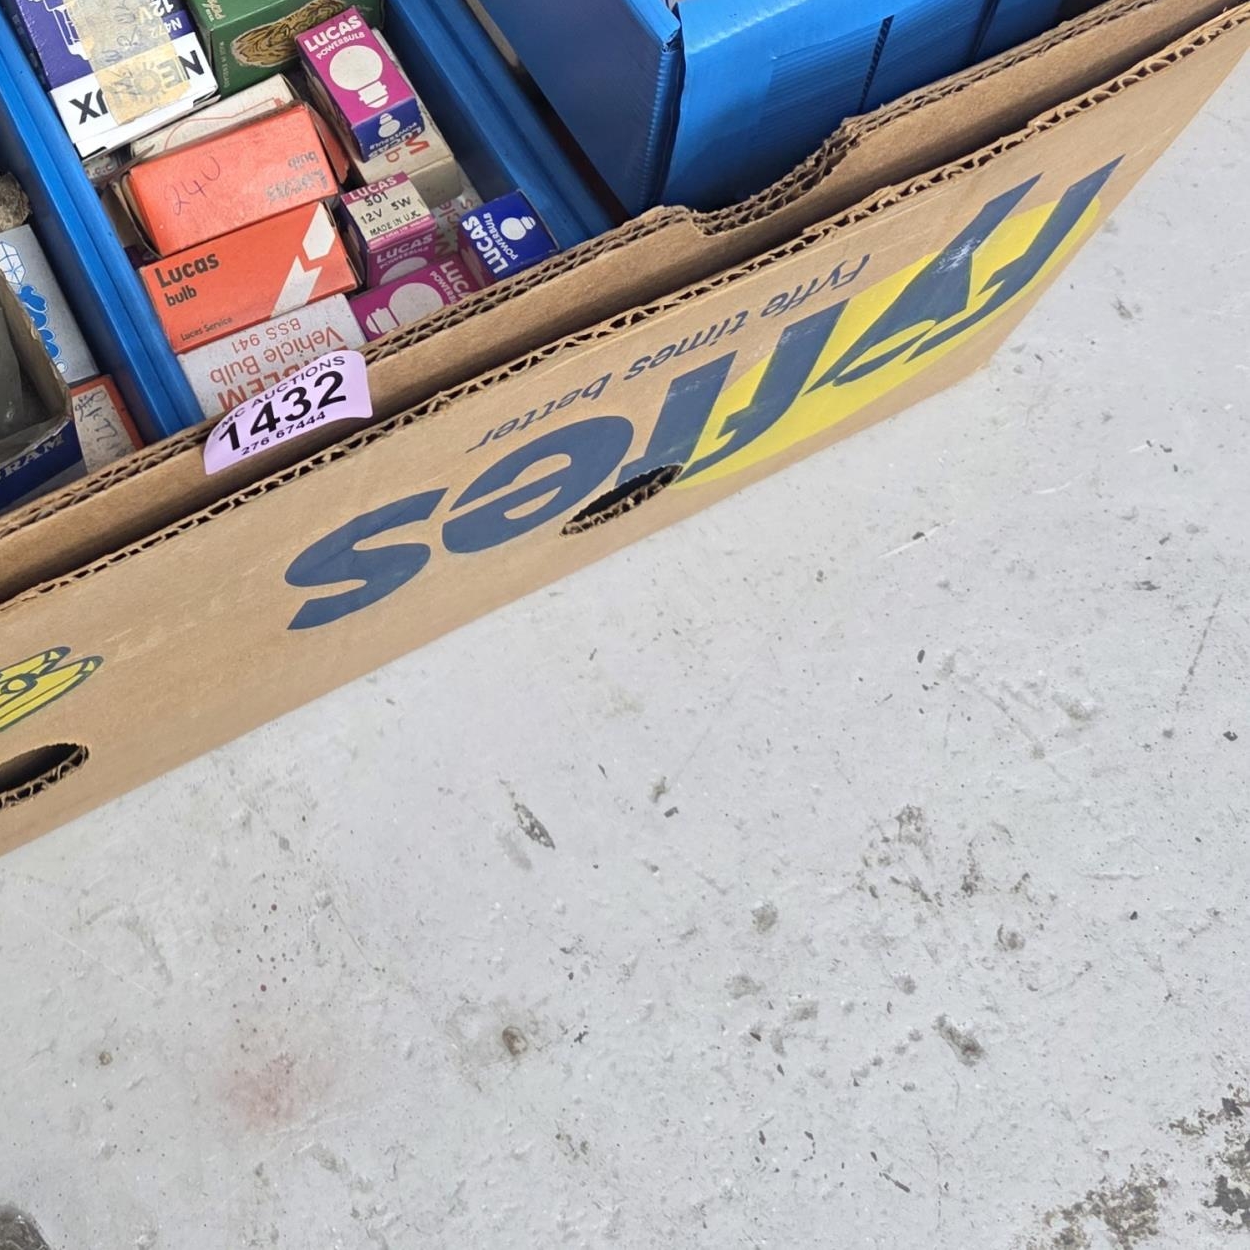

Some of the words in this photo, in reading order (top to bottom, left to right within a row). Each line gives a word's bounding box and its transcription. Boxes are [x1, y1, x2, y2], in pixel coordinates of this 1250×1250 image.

[151, 17, 182, 39] N472
[304, 16, 362, 52] LUCAS
[316, 32, 365, 59] POWERBULB
[350, 177, 397, 200] LUCAS
[364, 191, 389, 207] 501
[360, 209, 383, 225] 12V
[391, 196, 411, 211] 5W
[369, 221, 393, 236] MADE
[393, 217, 402, 227] IN
[377, 234, 434, 263] LUCAS
[462, 215, 509, 274] LUCAS
[482, 212, 519, 260] POWERBULB
[154, 252, 220, 288] Lucas
[440, 260, 470, 297] LUC
[761, 254, 870, 318] Fyffe
[164, 284, 197, 307] bulb
[180, 327, 203, 341] Lucas
[203, 317, 233, 332] Service
[232, 334, 260, 354] 941
[263, 326, 344, 363] Vehicle
[623, 310, 748, 381] times
[210, 355, 261, 388] Bulb
[251, 356, 345, 409] AUCTIONS
[219, 370, 347, 451] 1432
[466, 372, 612, 454] better
[242, 437, 270, 455] 276
[276, 411, 326, 438] 67444
